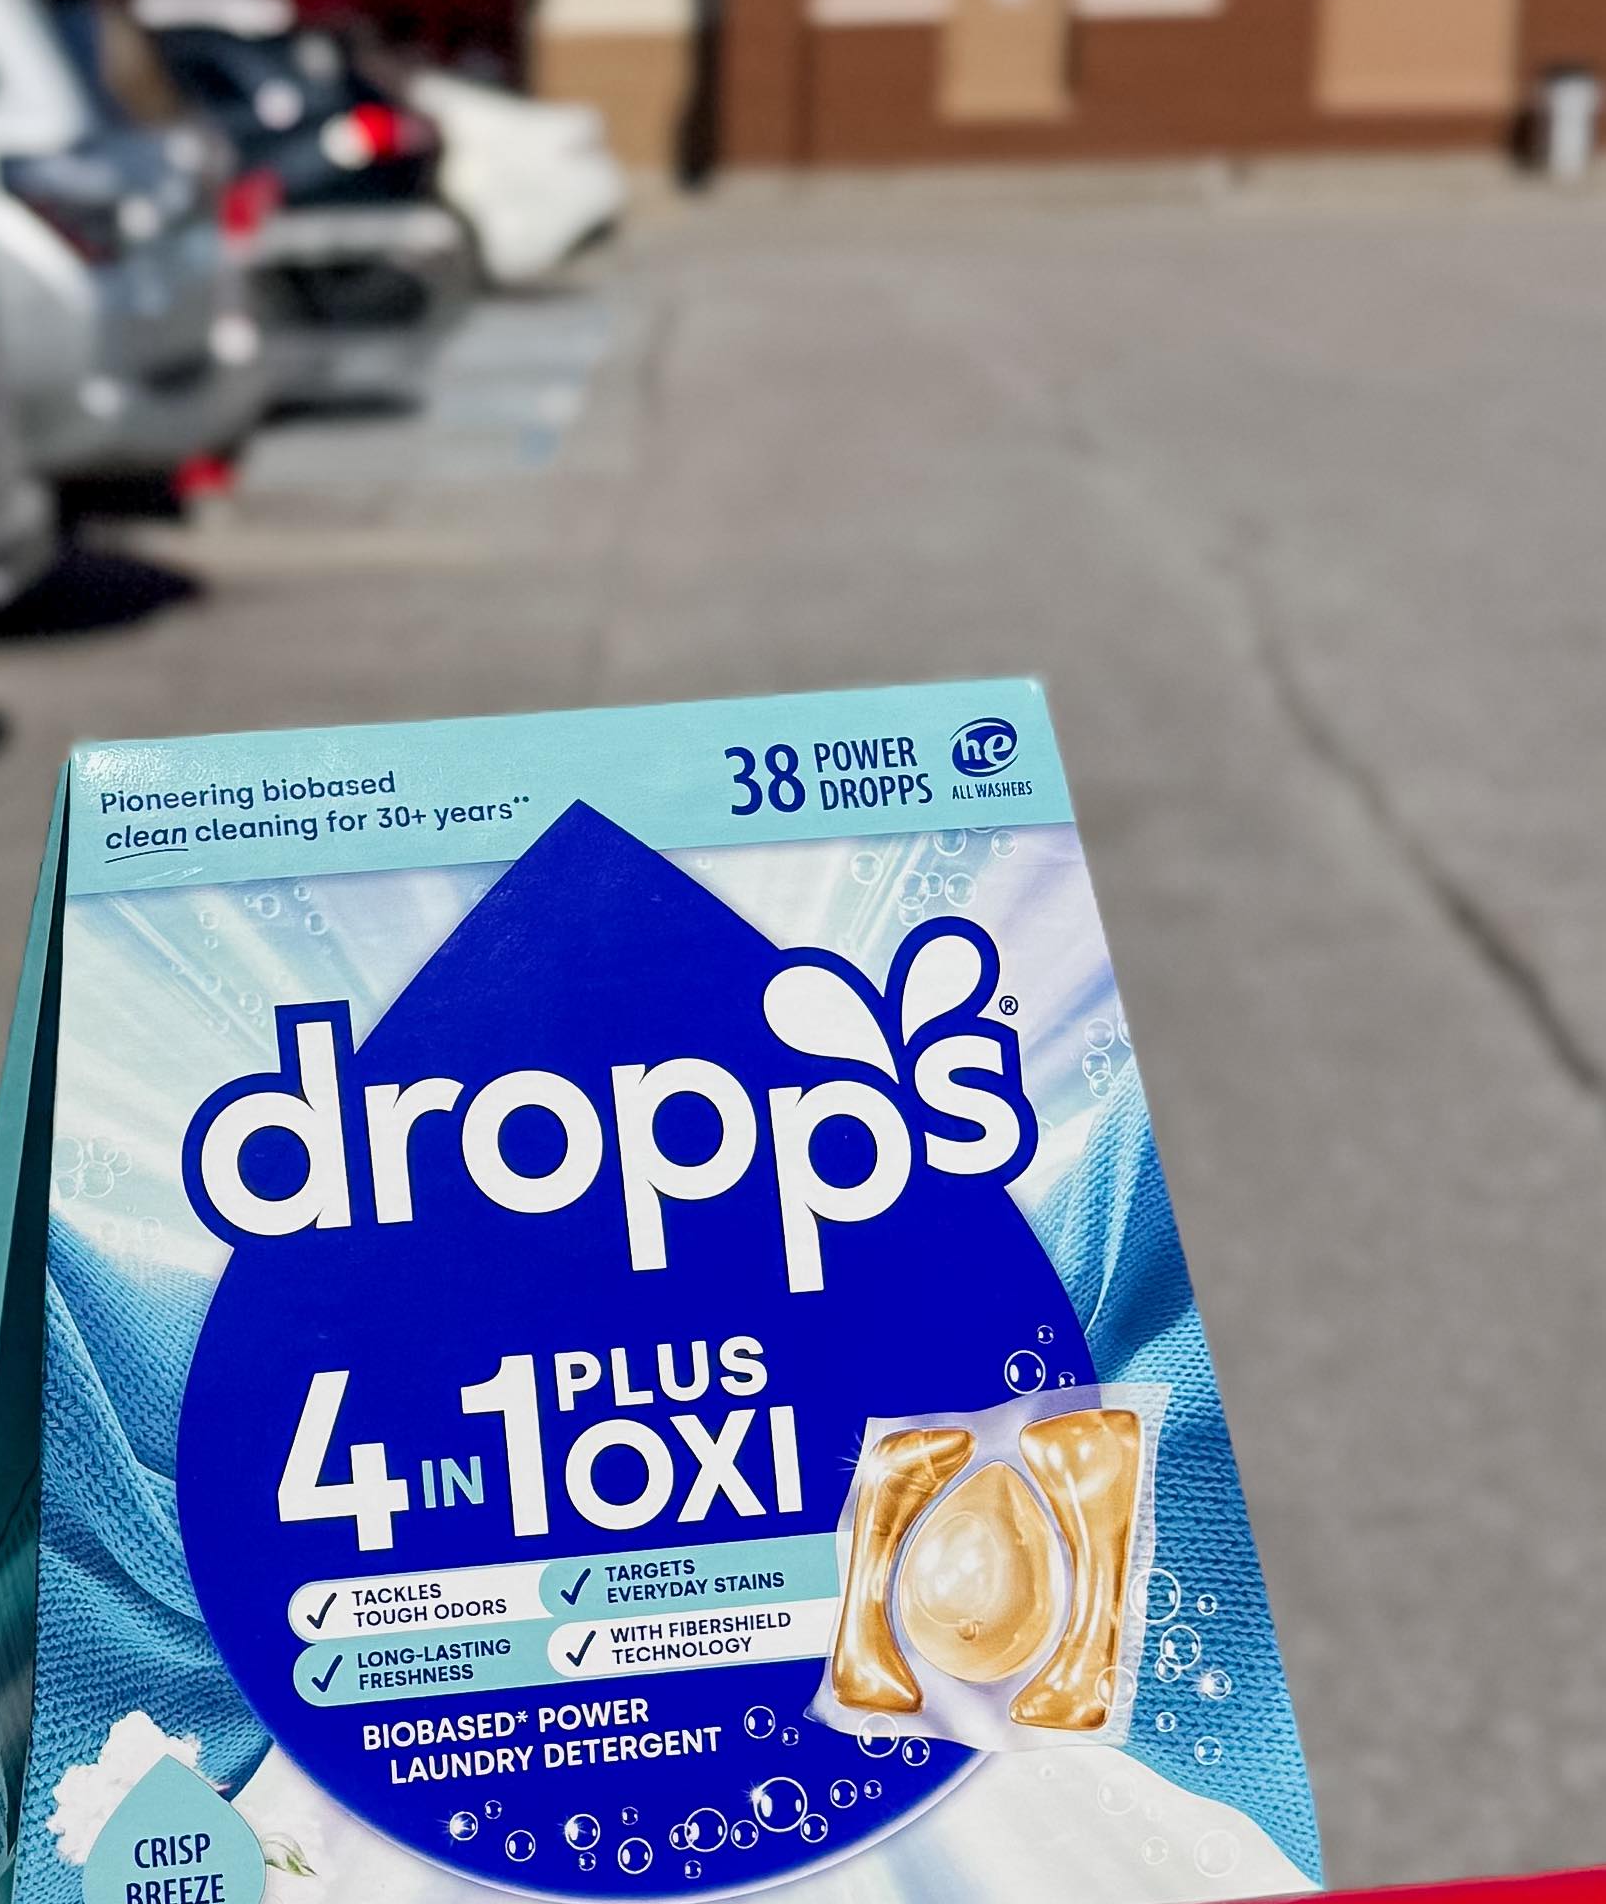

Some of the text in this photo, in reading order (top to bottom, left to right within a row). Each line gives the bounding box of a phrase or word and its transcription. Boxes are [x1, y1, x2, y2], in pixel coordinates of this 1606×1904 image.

[100, 771, 395, 814] Pioneering biobased
[724, 736, 918, 816] 38 POWER
[820, 773, 933, 810] DROPPS
[952, 780, 1032, 800] ALL WASHERS
[105, 825, 188, 850] clean
[195, 813, 318, 843] cleaning
[326, 810, 367, 832] for
[376, 805, 427, 828] 30+
[554, 1335, 770, 1414] PLUS
[278, 1353, 549, 1553] 4 IN 1
[564, 1405, 804, 1532] OXI
[605, 1559, 695, 1582] TARGETS
[607, 1572, 785, 1604] EVERYDAY STAINS
[352, 1583, 442, 1607] TACKLES
[353, 1599, 507, 1629] TOUGH ODORS
[610, 1612, 792, 1644] WITH FIBERSHIELD
[357, 1638, 511, 1669] LONG-LASTING
[612, 1636, 753, 1666] TECHNOLOGY
[358, 1664, 474, 1690] FRESHNESS
[537, 1697, 650, 1734] POWER
[390, 1726, 722, 1786] LAUNDRY DETERGENT
[133, 1833, 212, 1869] CRISP
